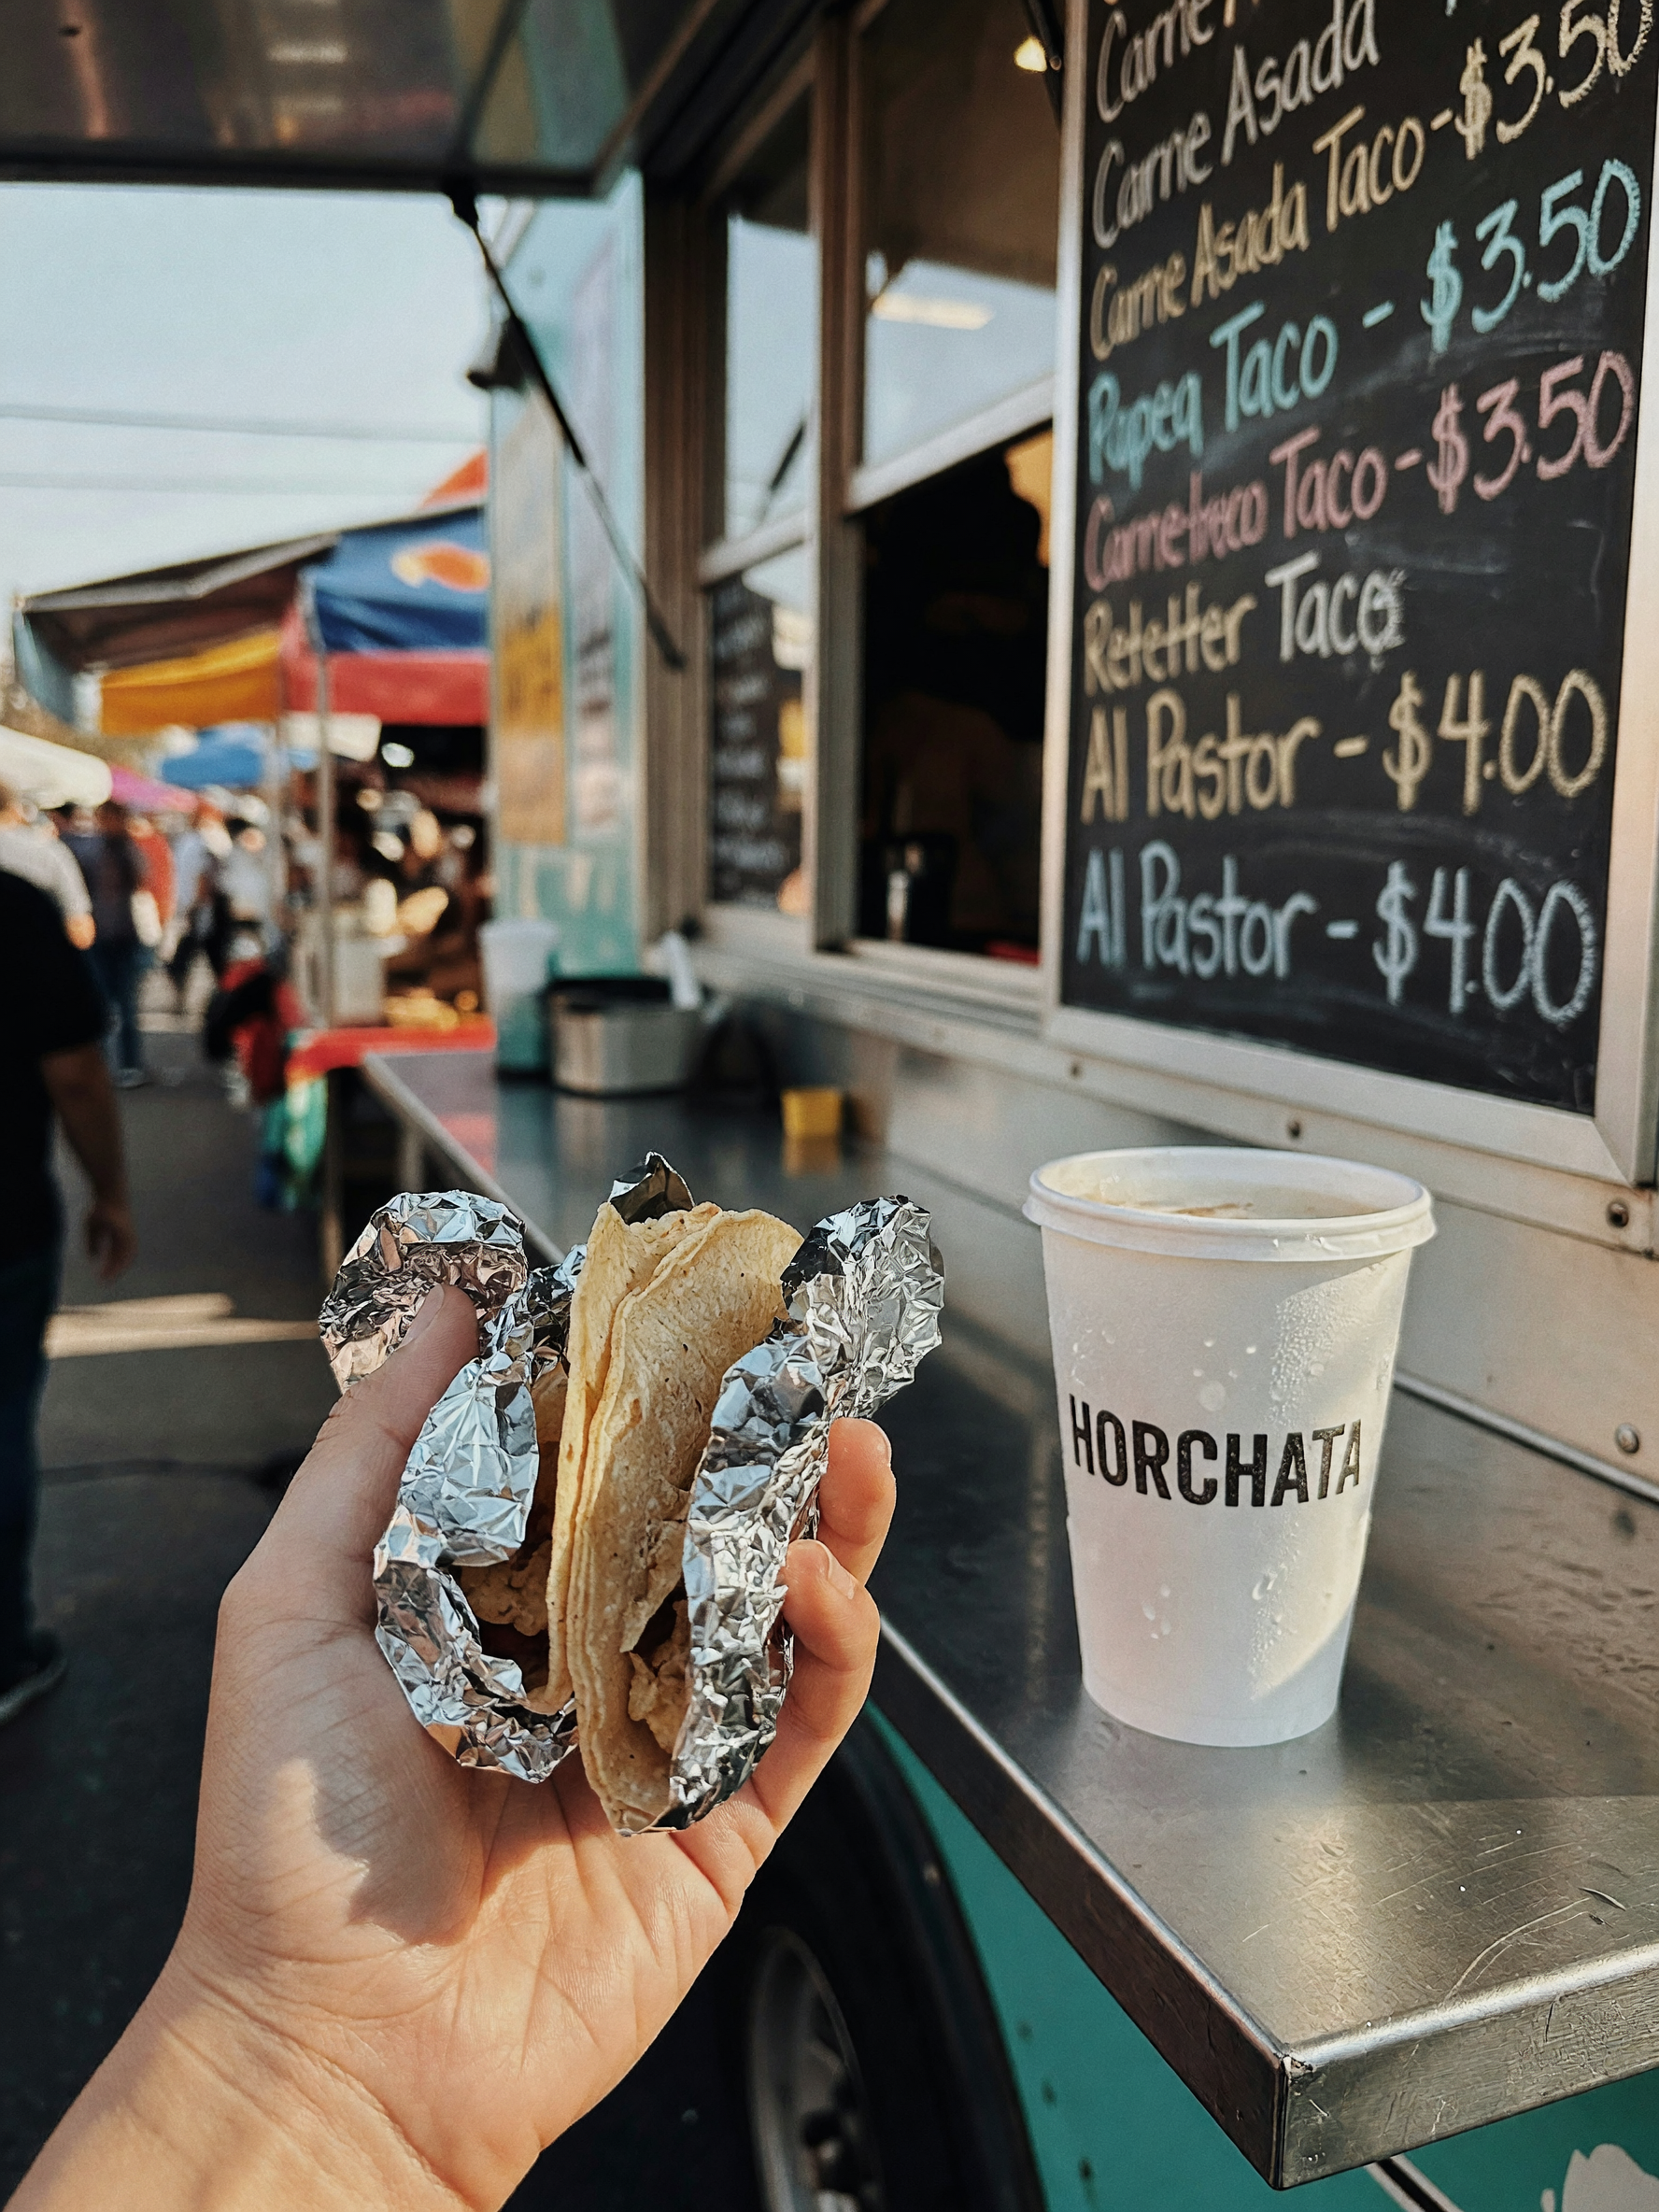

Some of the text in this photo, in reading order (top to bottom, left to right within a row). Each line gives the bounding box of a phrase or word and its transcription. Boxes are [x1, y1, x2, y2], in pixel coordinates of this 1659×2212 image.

[1093, 0, 1381, 248] Carne Asada
[1190, 160, 1309, 308] Asada
[1312, 104, 1425, 233] Taco
[1209, 298, 1340, 432] Taco
[1420, 157, 1641, 354] $3.50
[1268, 425, 1389, 540] Taco
[1426, 349, 1636, 515] $3.50
[1081, 704, 1129, 826] Al
[1146, 688, 1323, 820] Pastor
[1382, 668, 1609, 815] $4.00
[1076, 847, 1125, 969] Al
[1140, 841, 1319, 981] Pastor
[1372, 859, 1596, 1027] $4.00
[1069, 1393, 1363, 1508] HORCHATA
